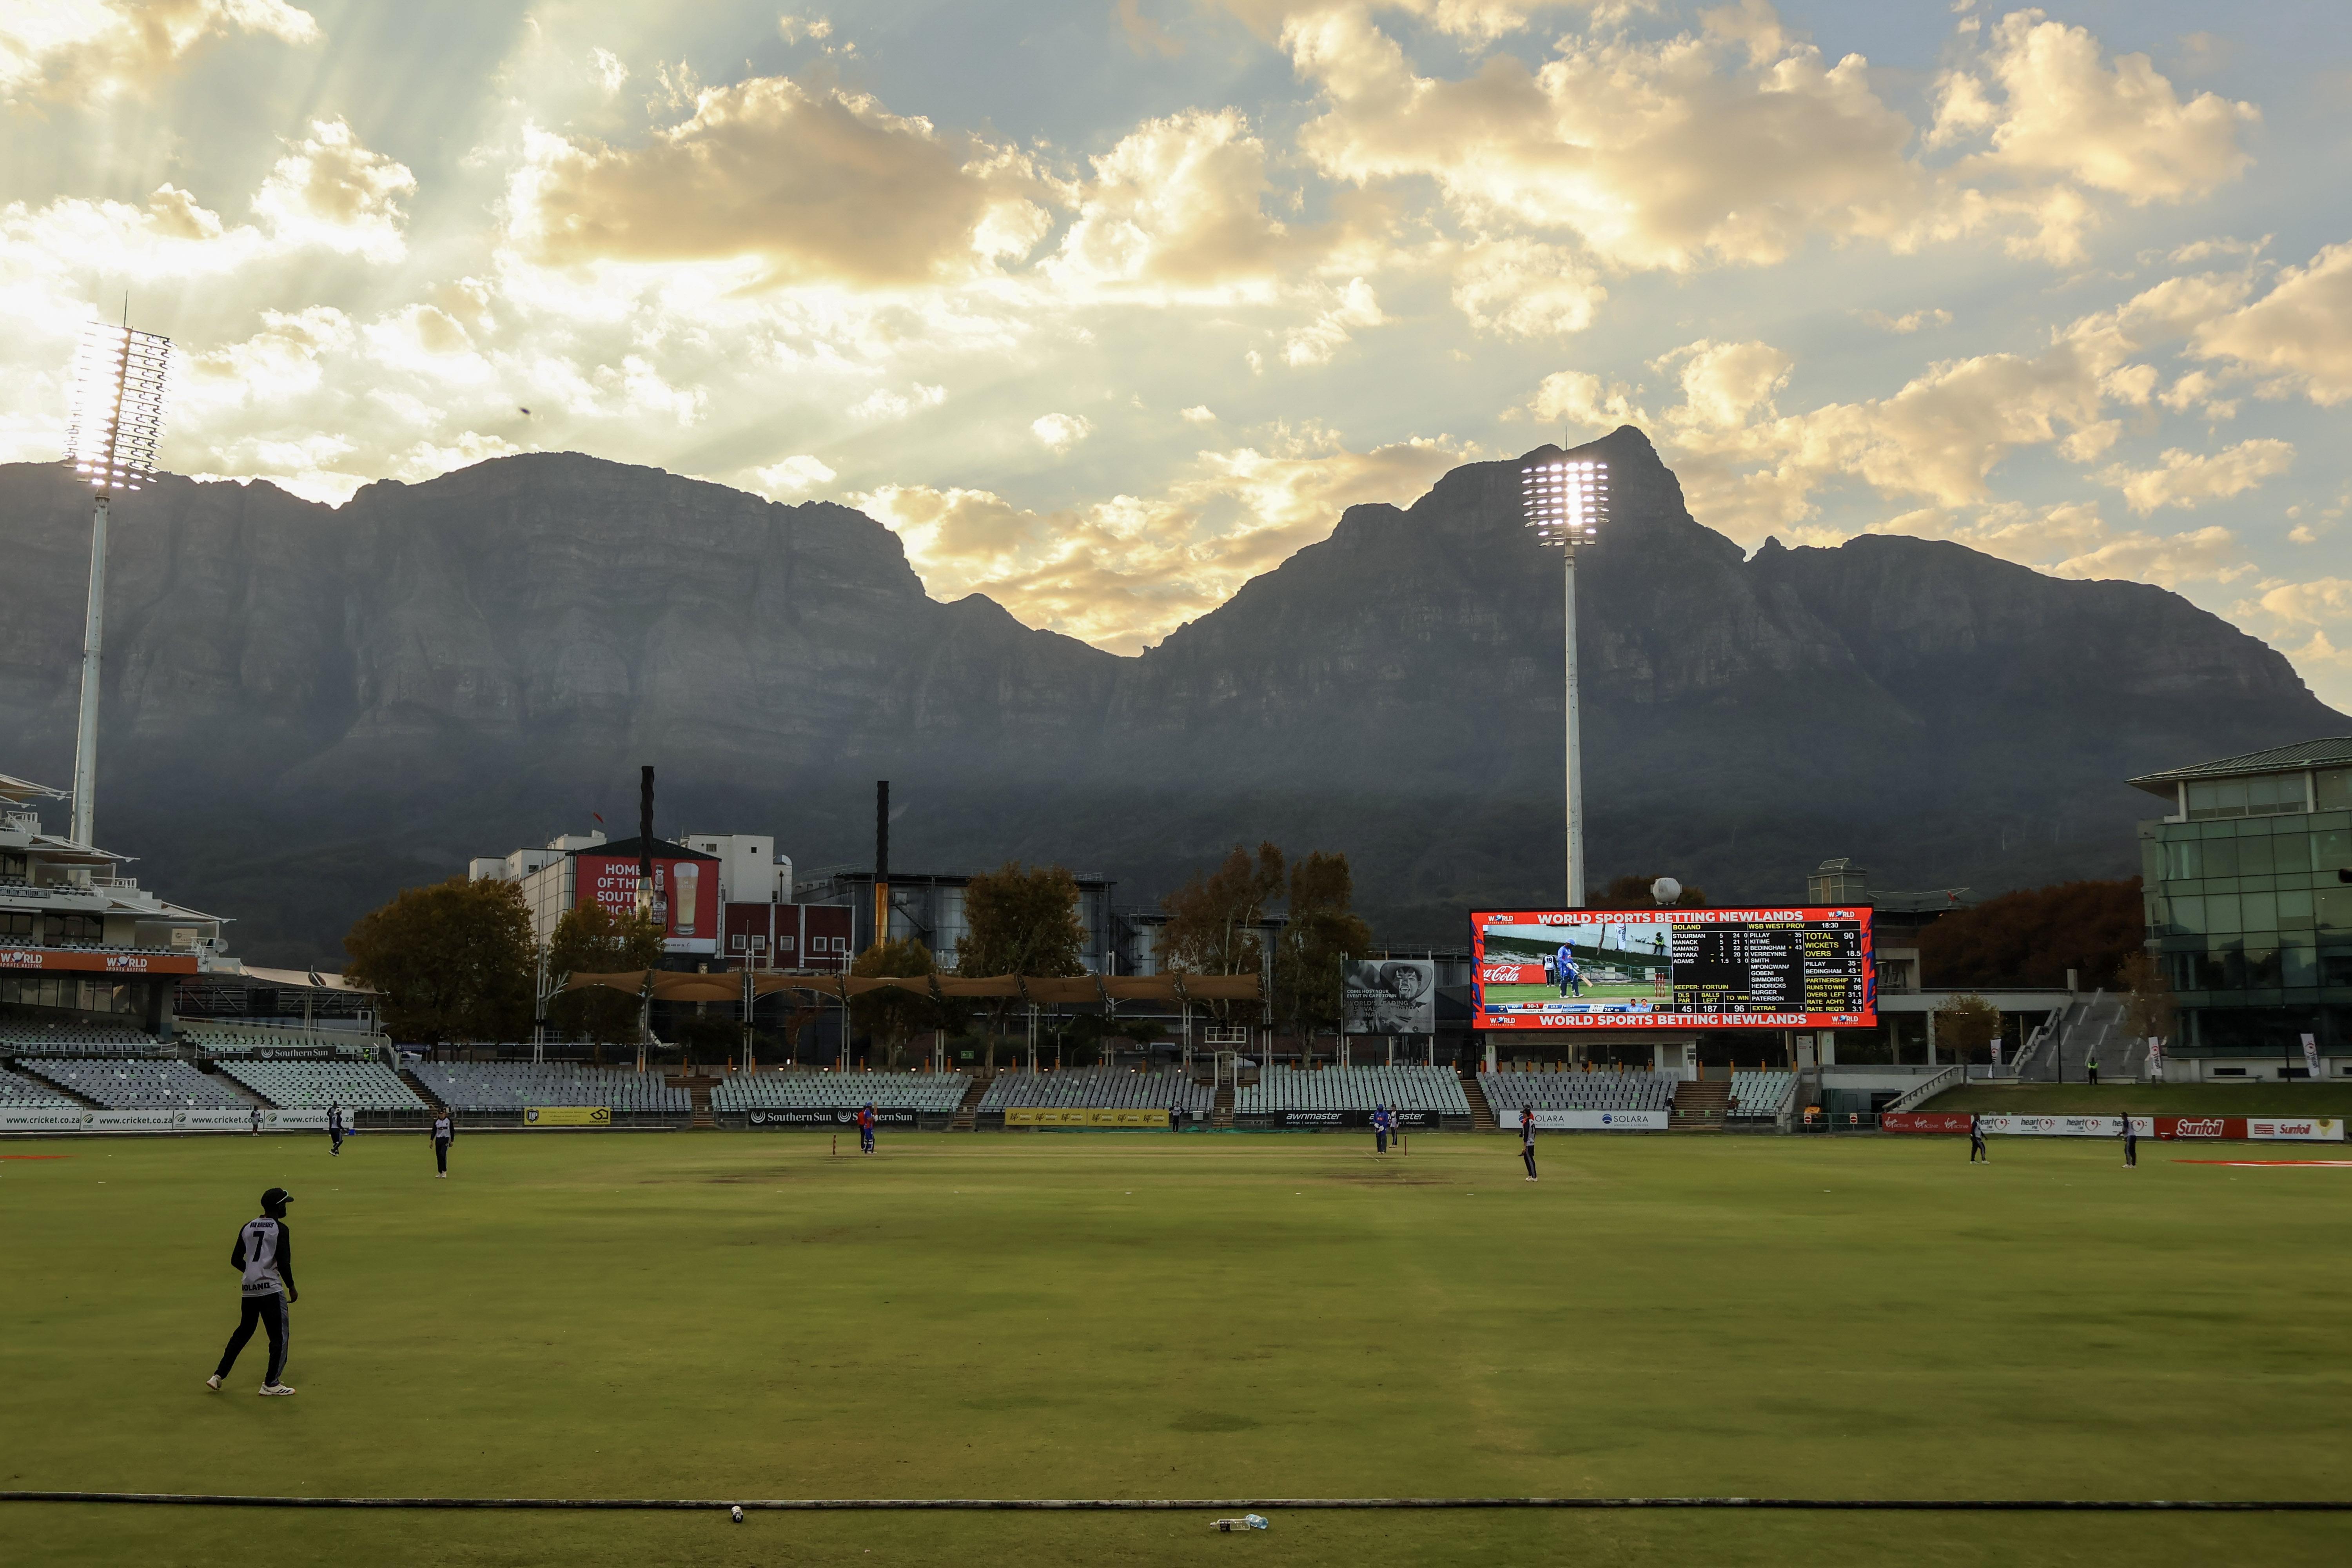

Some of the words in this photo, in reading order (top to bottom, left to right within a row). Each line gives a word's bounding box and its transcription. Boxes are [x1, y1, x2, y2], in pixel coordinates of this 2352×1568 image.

[606, 864, 640, 875] HOME
[597, 877, 614, 888] OF
[1537, 913, 1592, 924] WORLD
[1595, 913, 1651, 923] SPORTS
[1655, 912, 1715, 923] BETTING
[1719, 911, 1803, 922] NEWLANDS
[1539, 1015, 1593, 1025] WORLD
[1597, 1015, 1653, 1025] SPORTS
[1657, 1014, 1718, 1025] BETTING
[1722, 1014, 1807, 1024] NEWLANDS
[767, 1112, 812, 1122] Southern
[813, 1112, 832, 1121] Sun
[896, 1112, 913, 1121] Sun
[2177, 1120, 2224, 1136] Sunfoil
[2280, 1124, 2312, 1134] Sunfoil
[252, 1230, 265, 1262] 7
